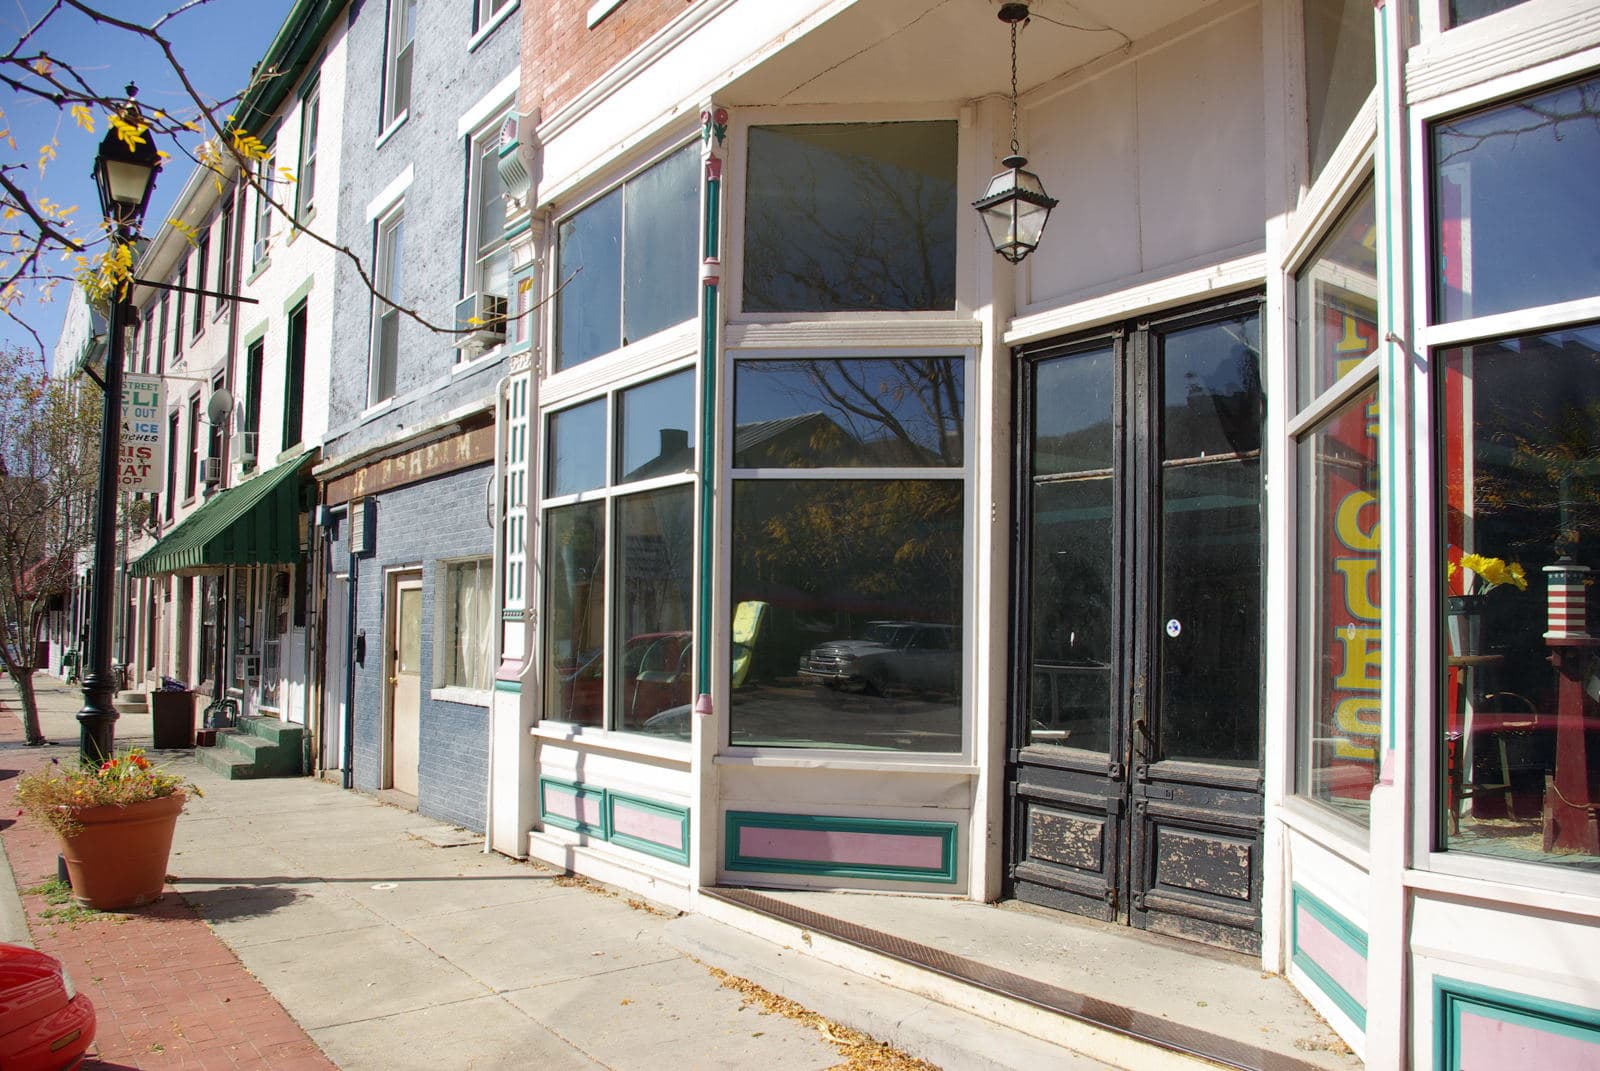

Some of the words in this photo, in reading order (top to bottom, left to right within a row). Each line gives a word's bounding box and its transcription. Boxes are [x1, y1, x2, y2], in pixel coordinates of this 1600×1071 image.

[121, 391, 158, 407] ELI
[135, 407, 157, 418] OUT
[135, 423, 159, 433] ICE
